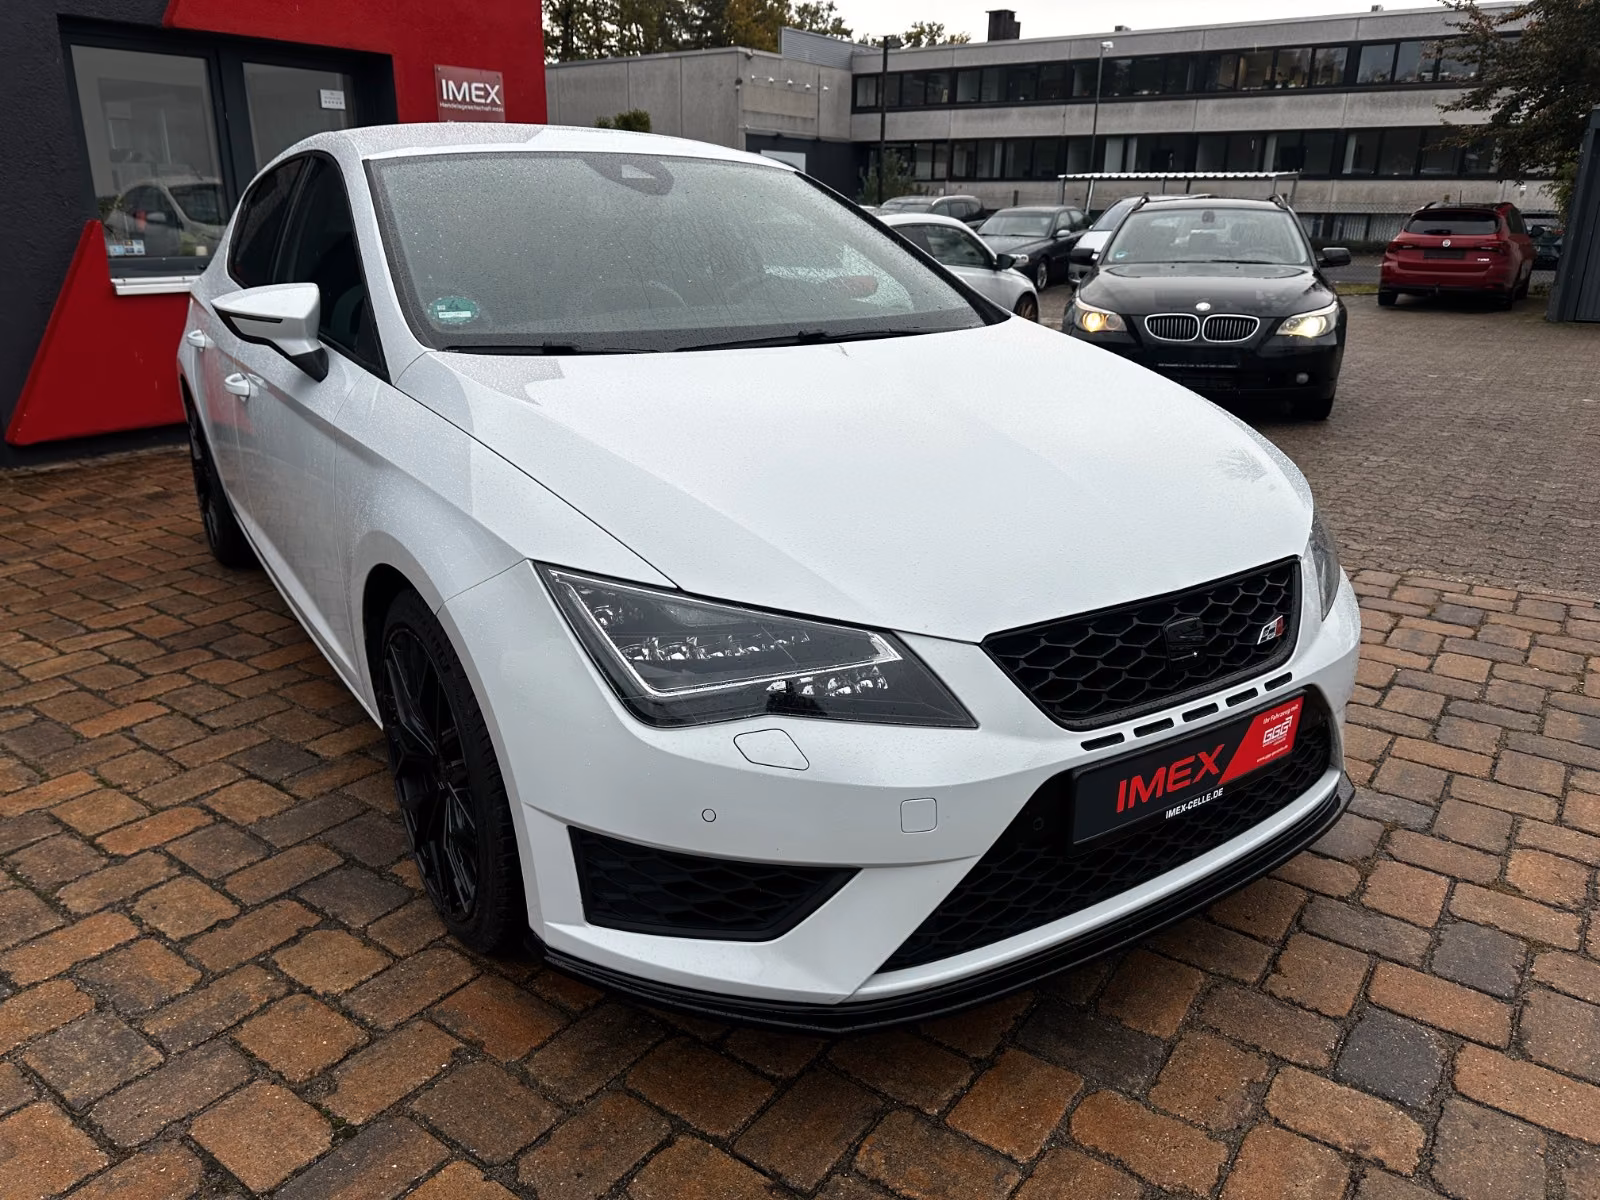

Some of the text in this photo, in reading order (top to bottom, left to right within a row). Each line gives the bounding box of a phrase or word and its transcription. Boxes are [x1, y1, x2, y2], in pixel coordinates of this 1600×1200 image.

[441, 79, 501, 105] IMEX
[1263, 720, 1289, 745] GGG
[1116, 743, 1225, 813] IMEX
[1165, 787, 1224, 819] IMEX-CELLE.DE
